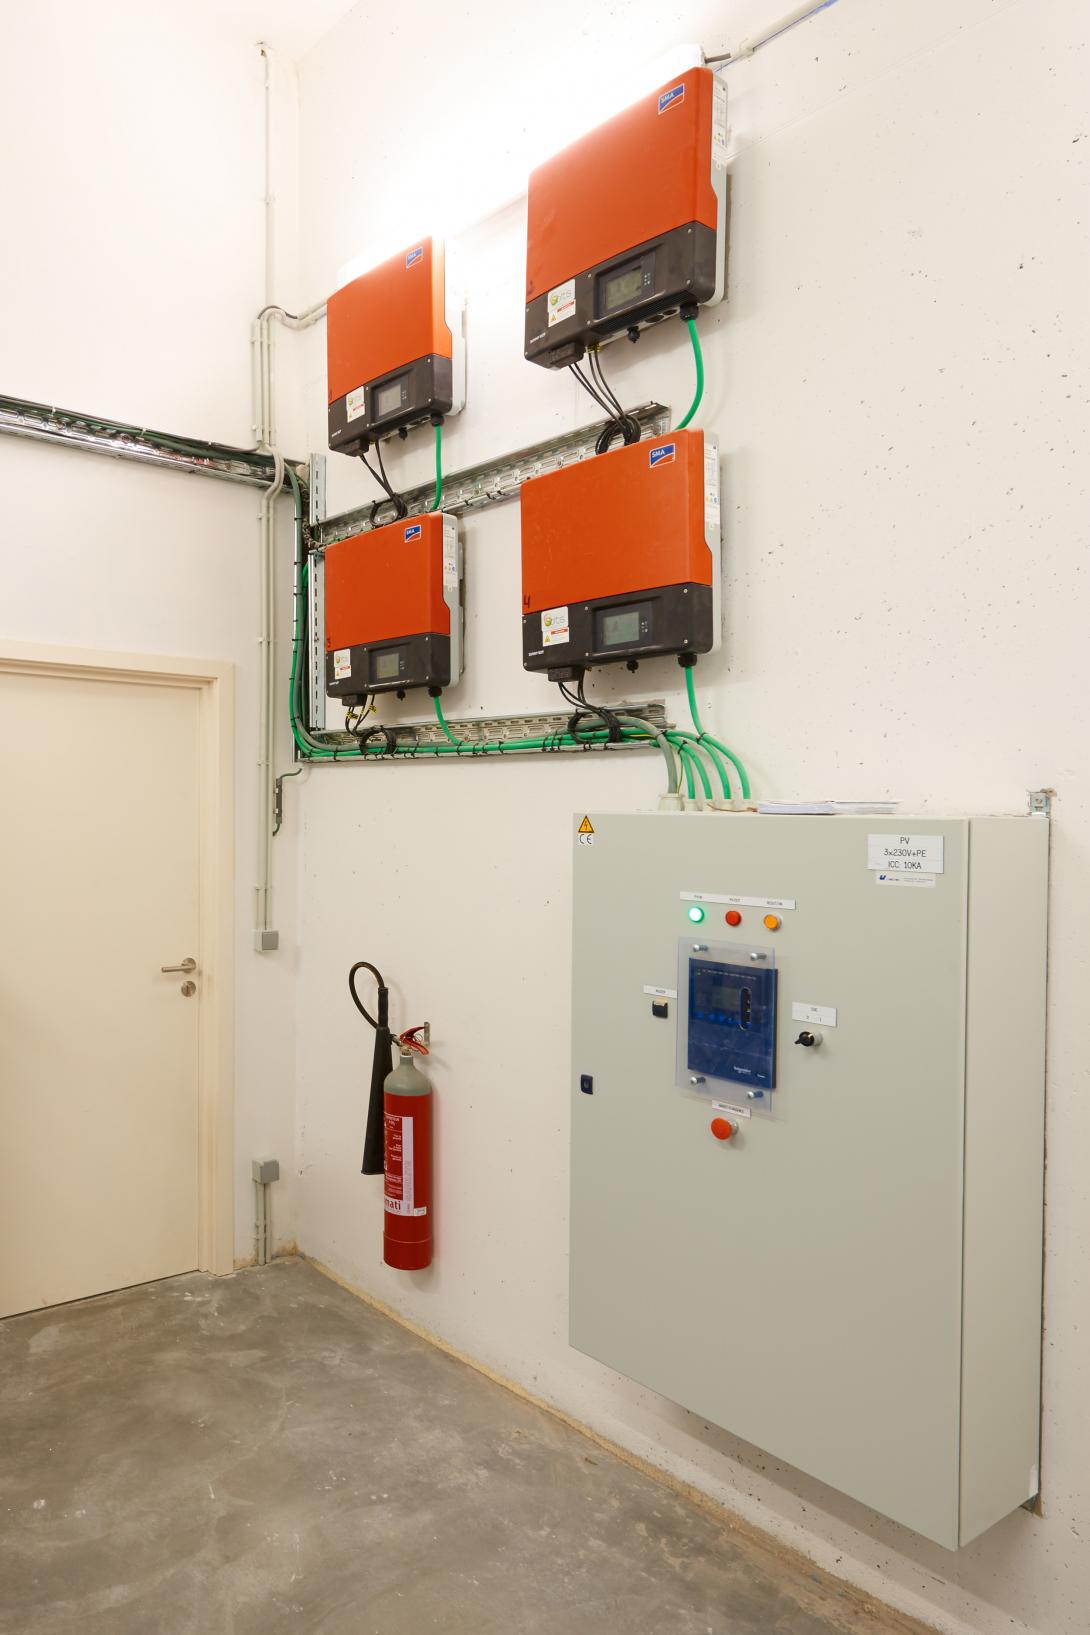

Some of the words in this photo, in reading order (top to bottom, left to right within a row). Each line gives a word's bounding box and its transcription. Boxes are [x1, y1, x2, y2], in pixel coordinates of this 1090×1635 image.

[651, 449, 665, 458] SMA
[900, 836, 910, 845] PV
[883, 848, 927, 858] 3x230V+PE
[888, 860, 900, 869] ICC
[904, 861, 922, 870] 10KA
